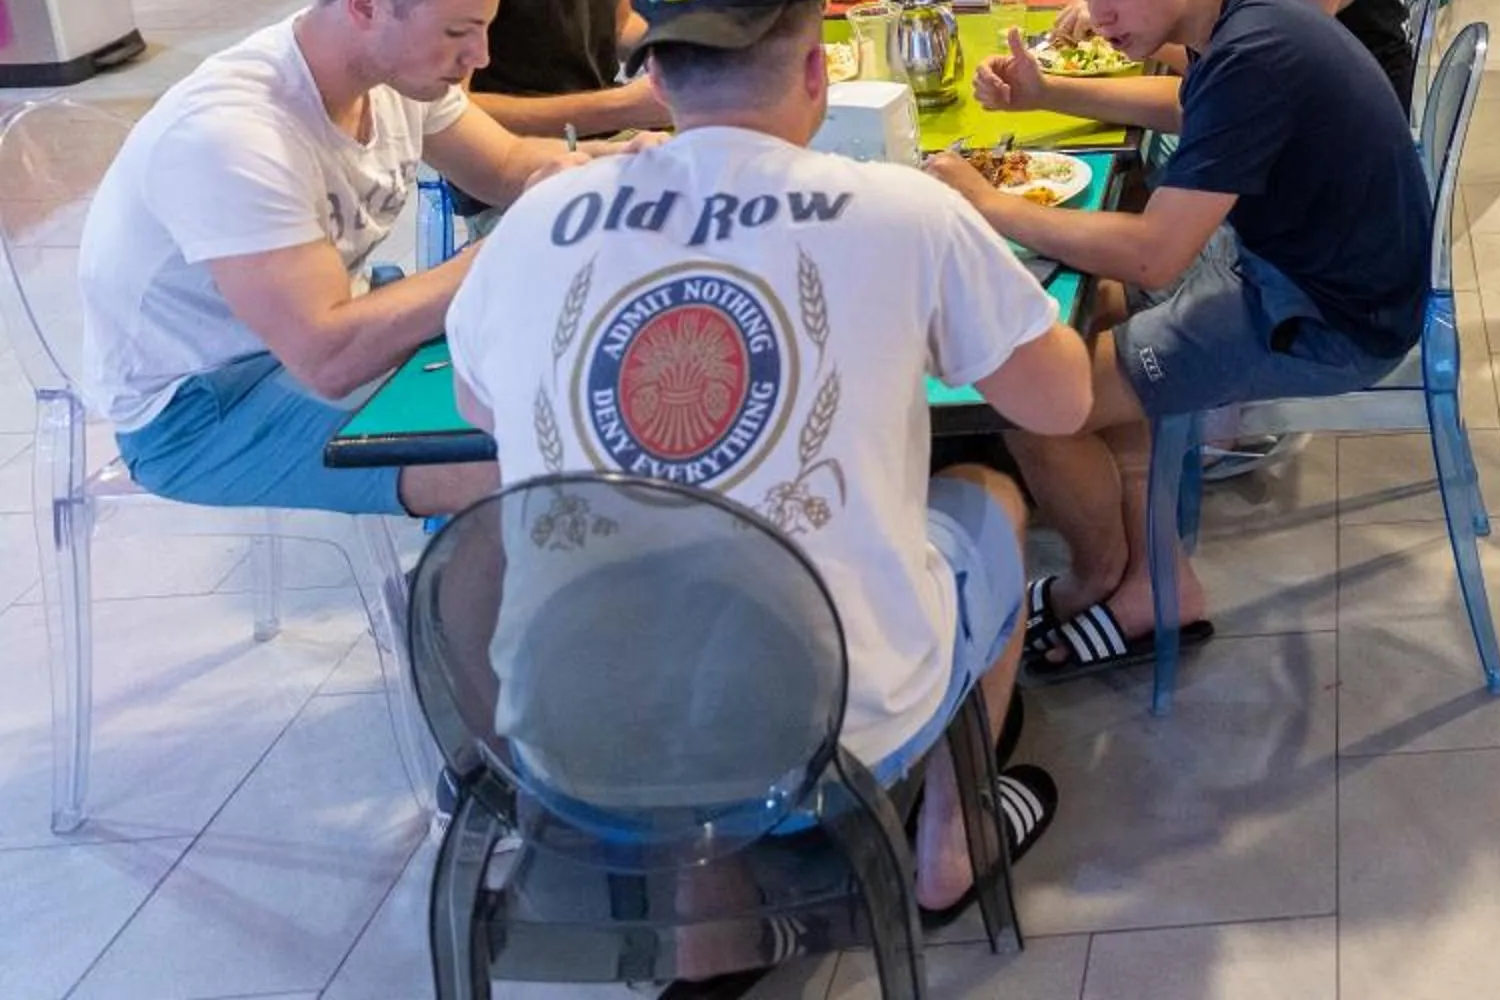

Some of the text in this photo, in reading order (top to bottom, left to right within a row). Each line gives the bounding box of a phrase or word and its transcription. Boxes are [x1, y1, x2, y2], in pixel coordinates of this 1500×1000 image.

[551, 186, 854, 247] Old Row
[602, 278, 775, 361] ADMIT NOTHING
[593, 379, 774, 485] DENY EVERYTHING
